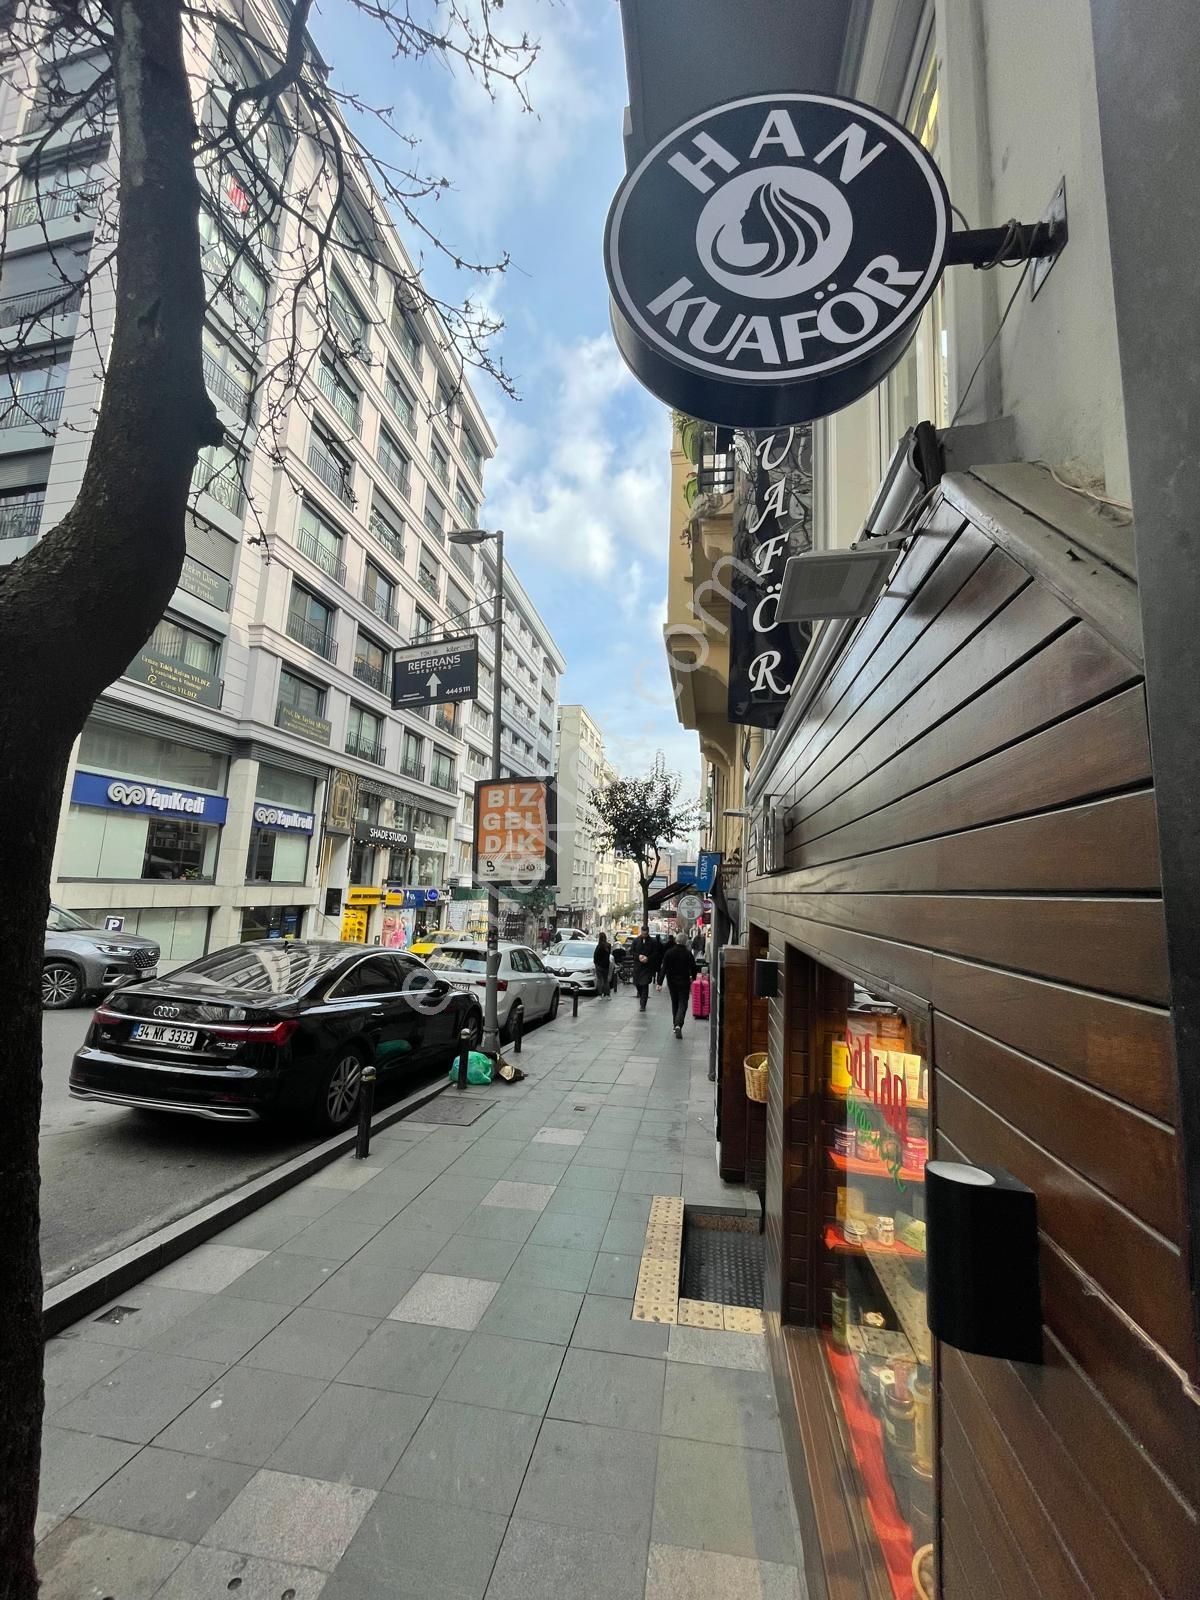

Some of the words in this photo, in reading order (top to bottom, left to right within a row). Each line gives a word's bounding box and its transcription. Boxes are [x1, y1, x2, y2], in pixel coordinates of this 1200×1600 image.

[667, 109, 888, 194] HAN
[647, 254, 923, 365] KUAFÖR
[408, 654, 461, 671] REFERANS
[487, 783, 538, 808] BİZ
[482, 810, 541, 831] GEL
[369, 827, 388, 840] SHADE
[388, 831, 408, 843] STUDIO
[108, 919, 120, 931] P
[137, 1025, 149, 1039] 34
[168, 1029, 195, 1045] 3333
